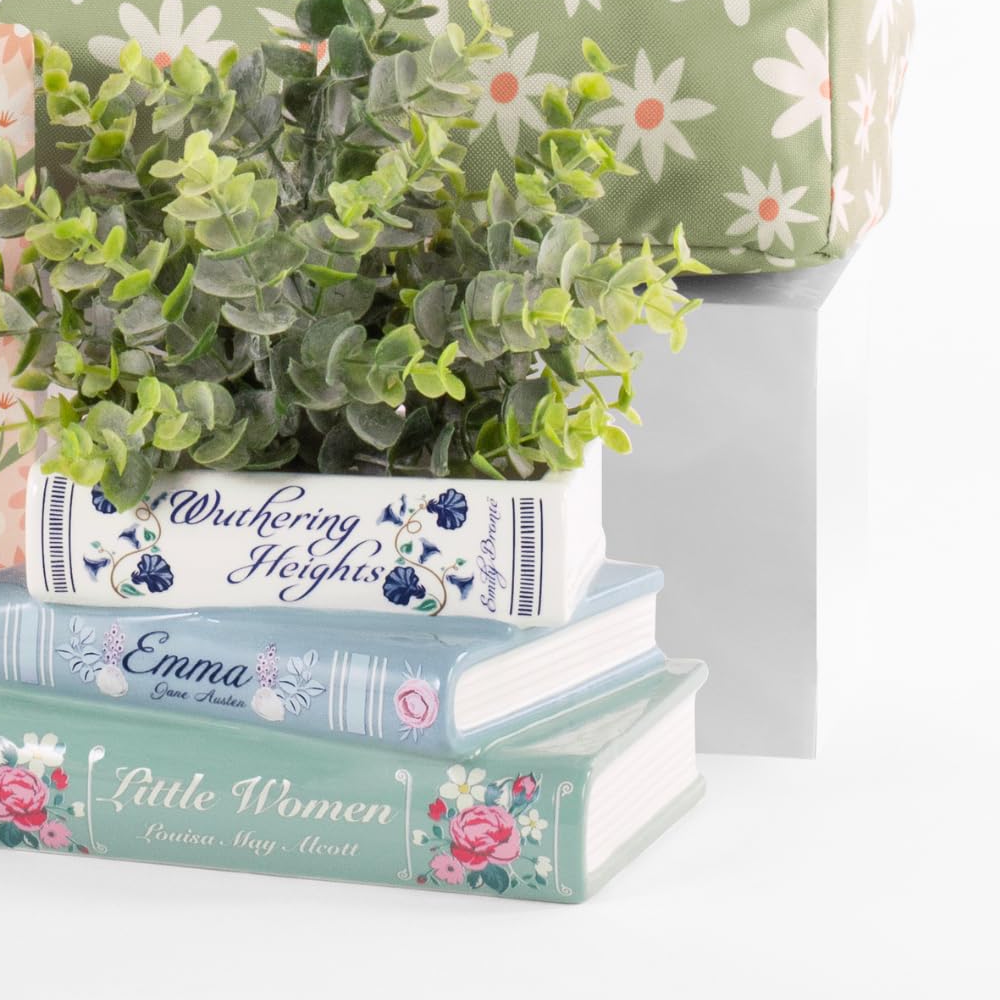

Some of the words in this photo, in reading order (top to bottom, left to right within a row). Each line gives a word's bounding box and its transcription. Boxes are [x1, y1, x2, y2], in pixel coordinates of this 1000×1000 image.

[169, 485, 361, 557] Wuthering
[226, 539, 385, 603] Heights
[476, 555, 507, 613] Emily
[122, 630, 254, 688] Emma
[151, 681, 187, 700] Jane
[194, 689, 246, 708] Austen
[96, 767, 216, 812] Little
[232, 775, 398, 825] Women
[136, 823, 215, 847] Louisa
[219, 830, 281, 857] May
[282, 835, 360, 857] Alcott
